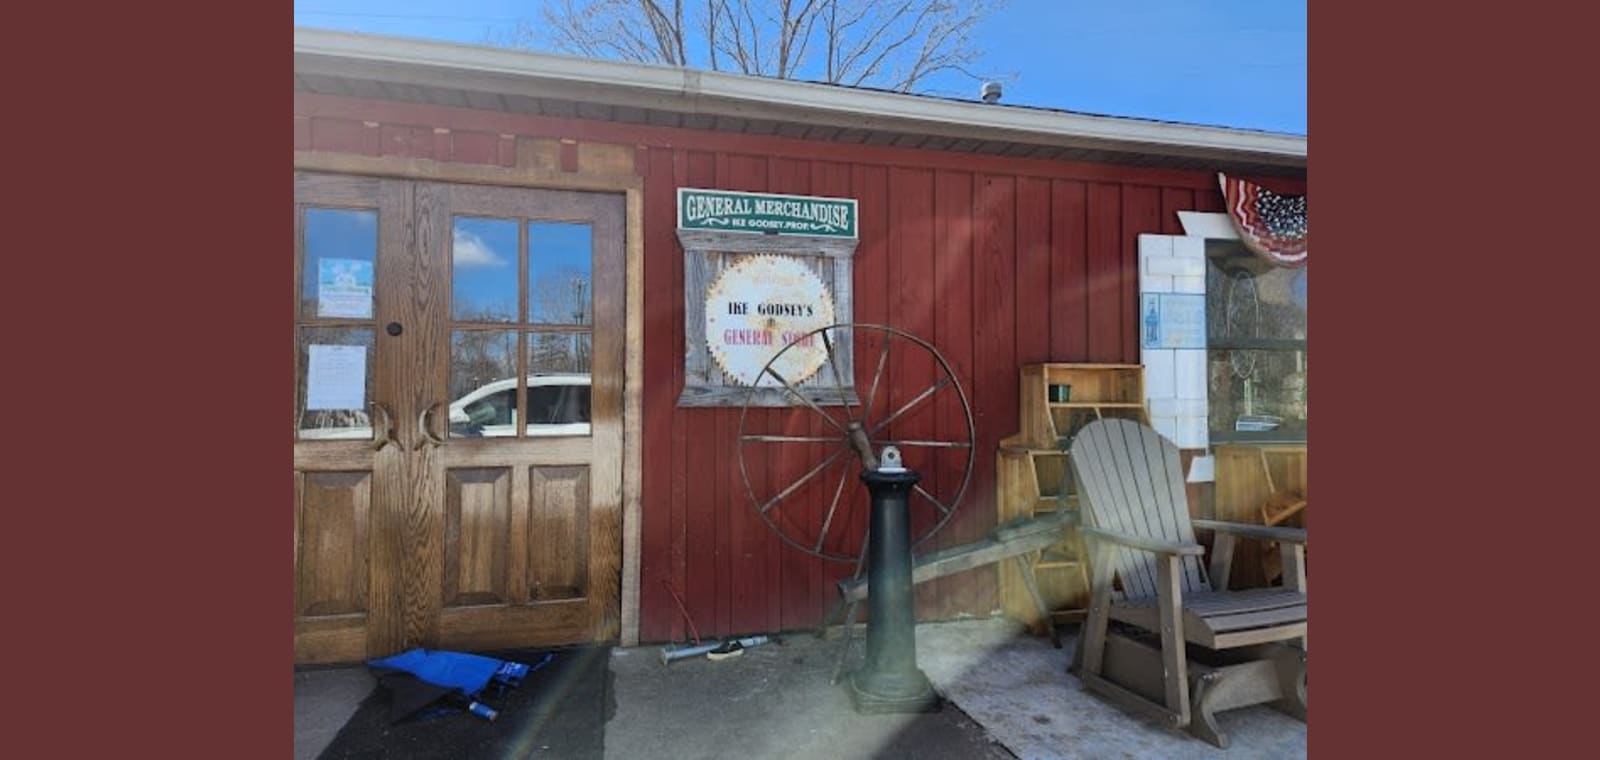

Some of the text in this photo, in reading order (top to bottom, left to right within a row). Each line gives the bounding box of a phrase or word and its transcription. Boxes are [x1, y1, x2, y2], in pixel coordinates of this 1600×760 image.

[686, 195, 849, 230] GENERAL MERCHANDISE
[732, 219, 746, 227] IKE
[728, 302, 813, 317] IKE GODSEY'S
[723, 329, 773, 346] GENERAL
